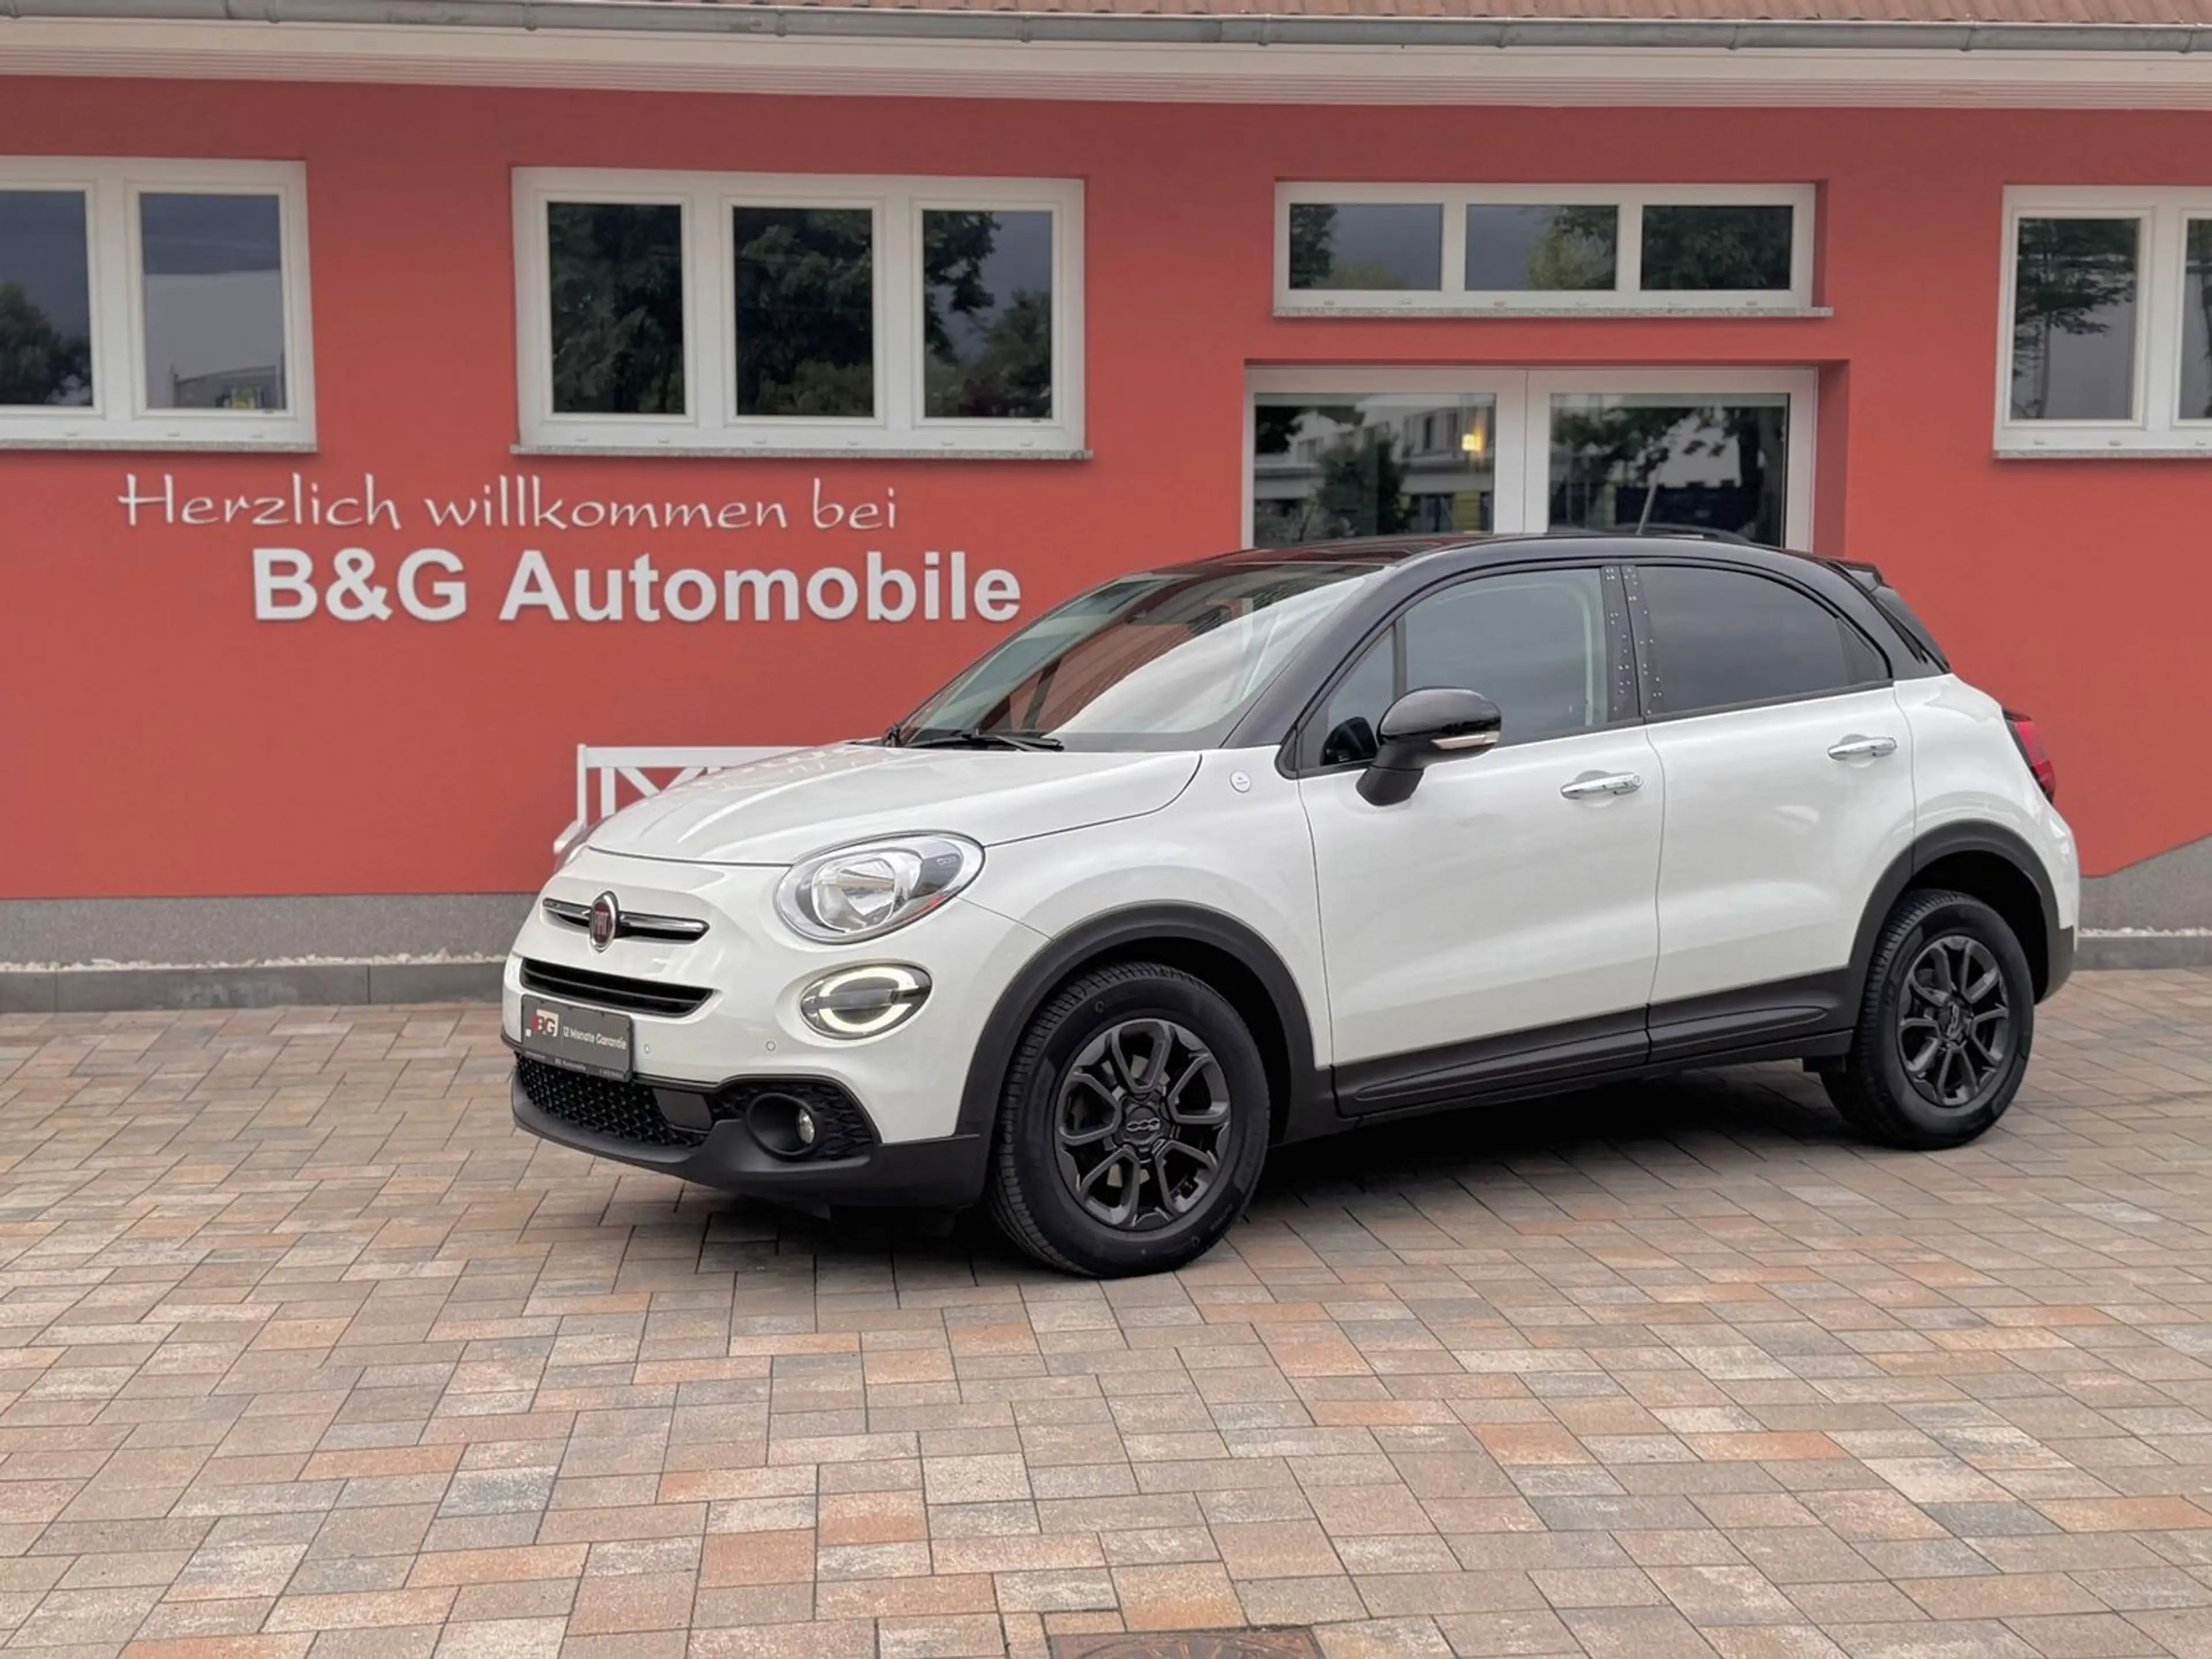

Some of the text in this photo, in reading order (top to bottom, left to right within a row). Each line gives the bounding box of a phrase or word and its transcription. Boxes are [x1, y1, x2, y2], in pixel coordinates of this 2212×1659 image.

[118, 472, 895, 530] Herzlich willkommen bei
[253, 547, 1021, 622] B&G Automobile
